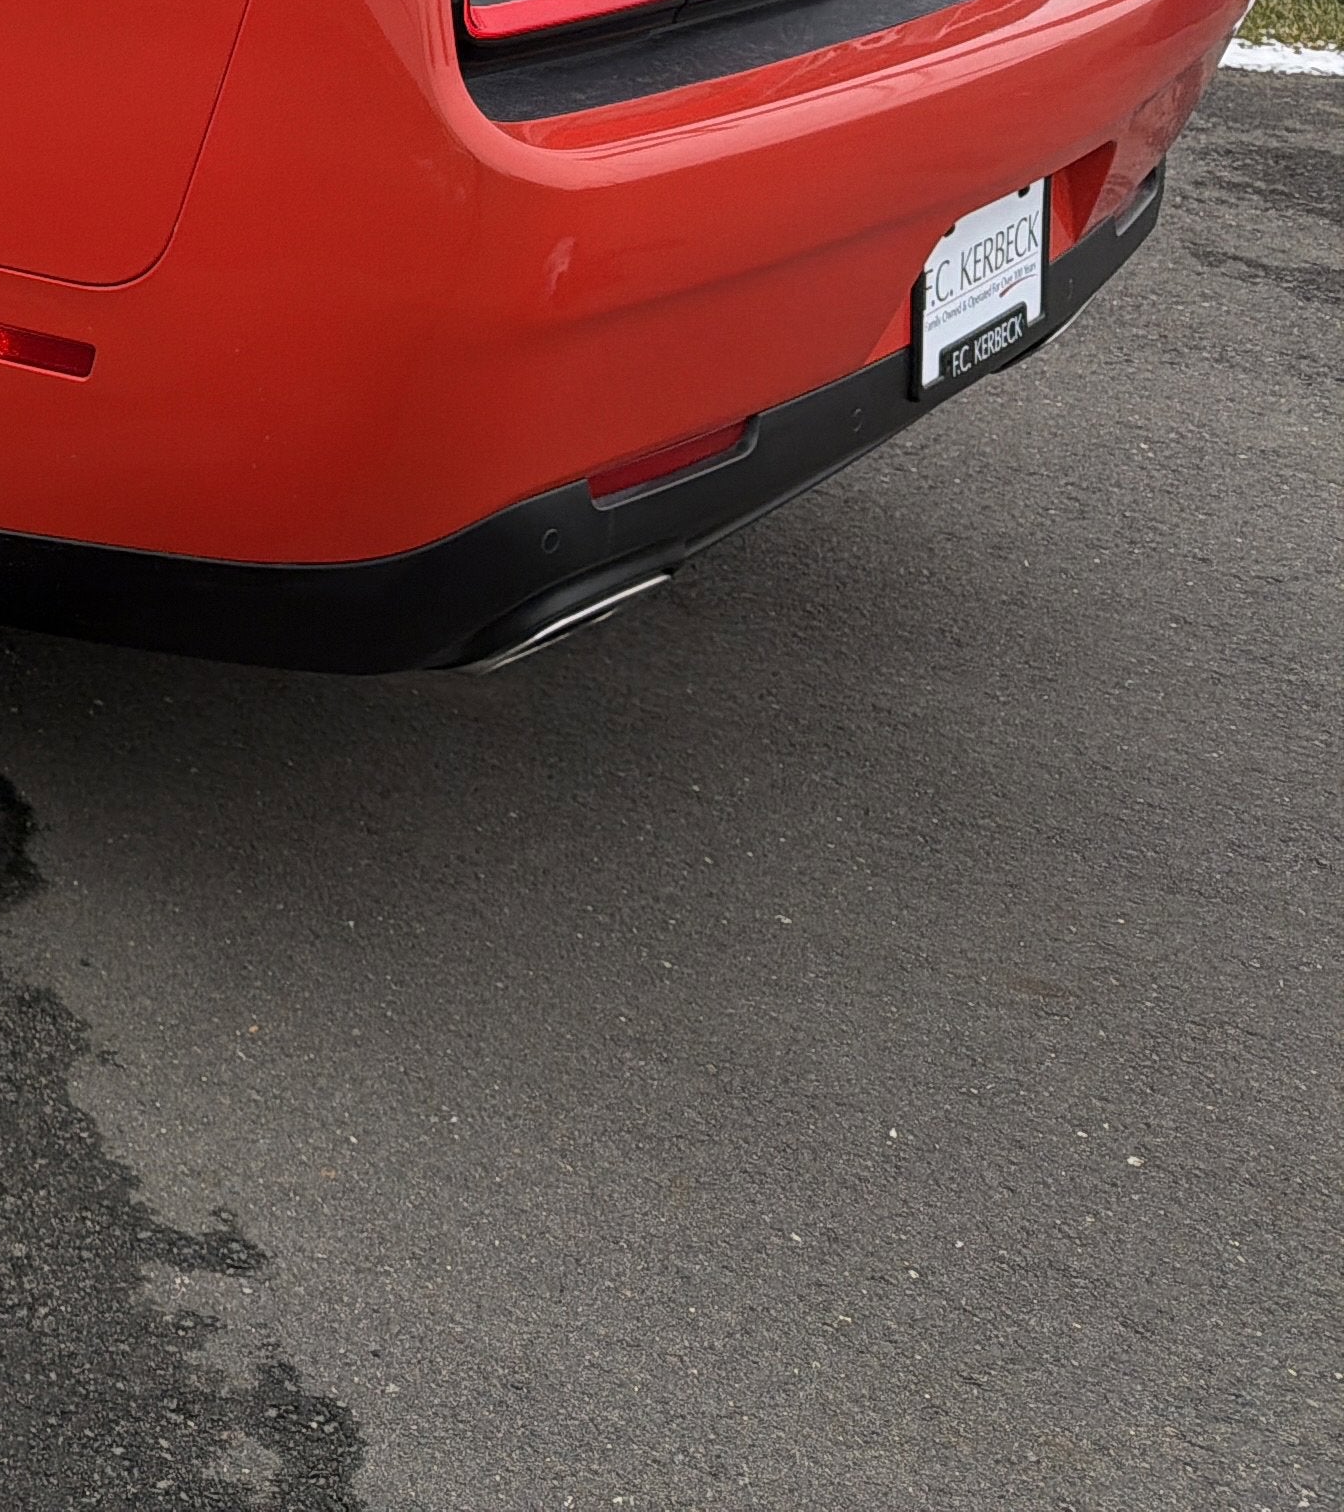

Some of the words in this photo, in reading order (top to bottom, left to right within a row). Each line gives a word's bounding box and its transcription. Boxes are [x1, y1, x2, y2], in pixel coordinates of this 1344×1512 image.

[960, 210, 1040, 291] KERBECK
[952, 345, 972, 377] F.C.
[974, 313, 1023, 365] KERBECK
